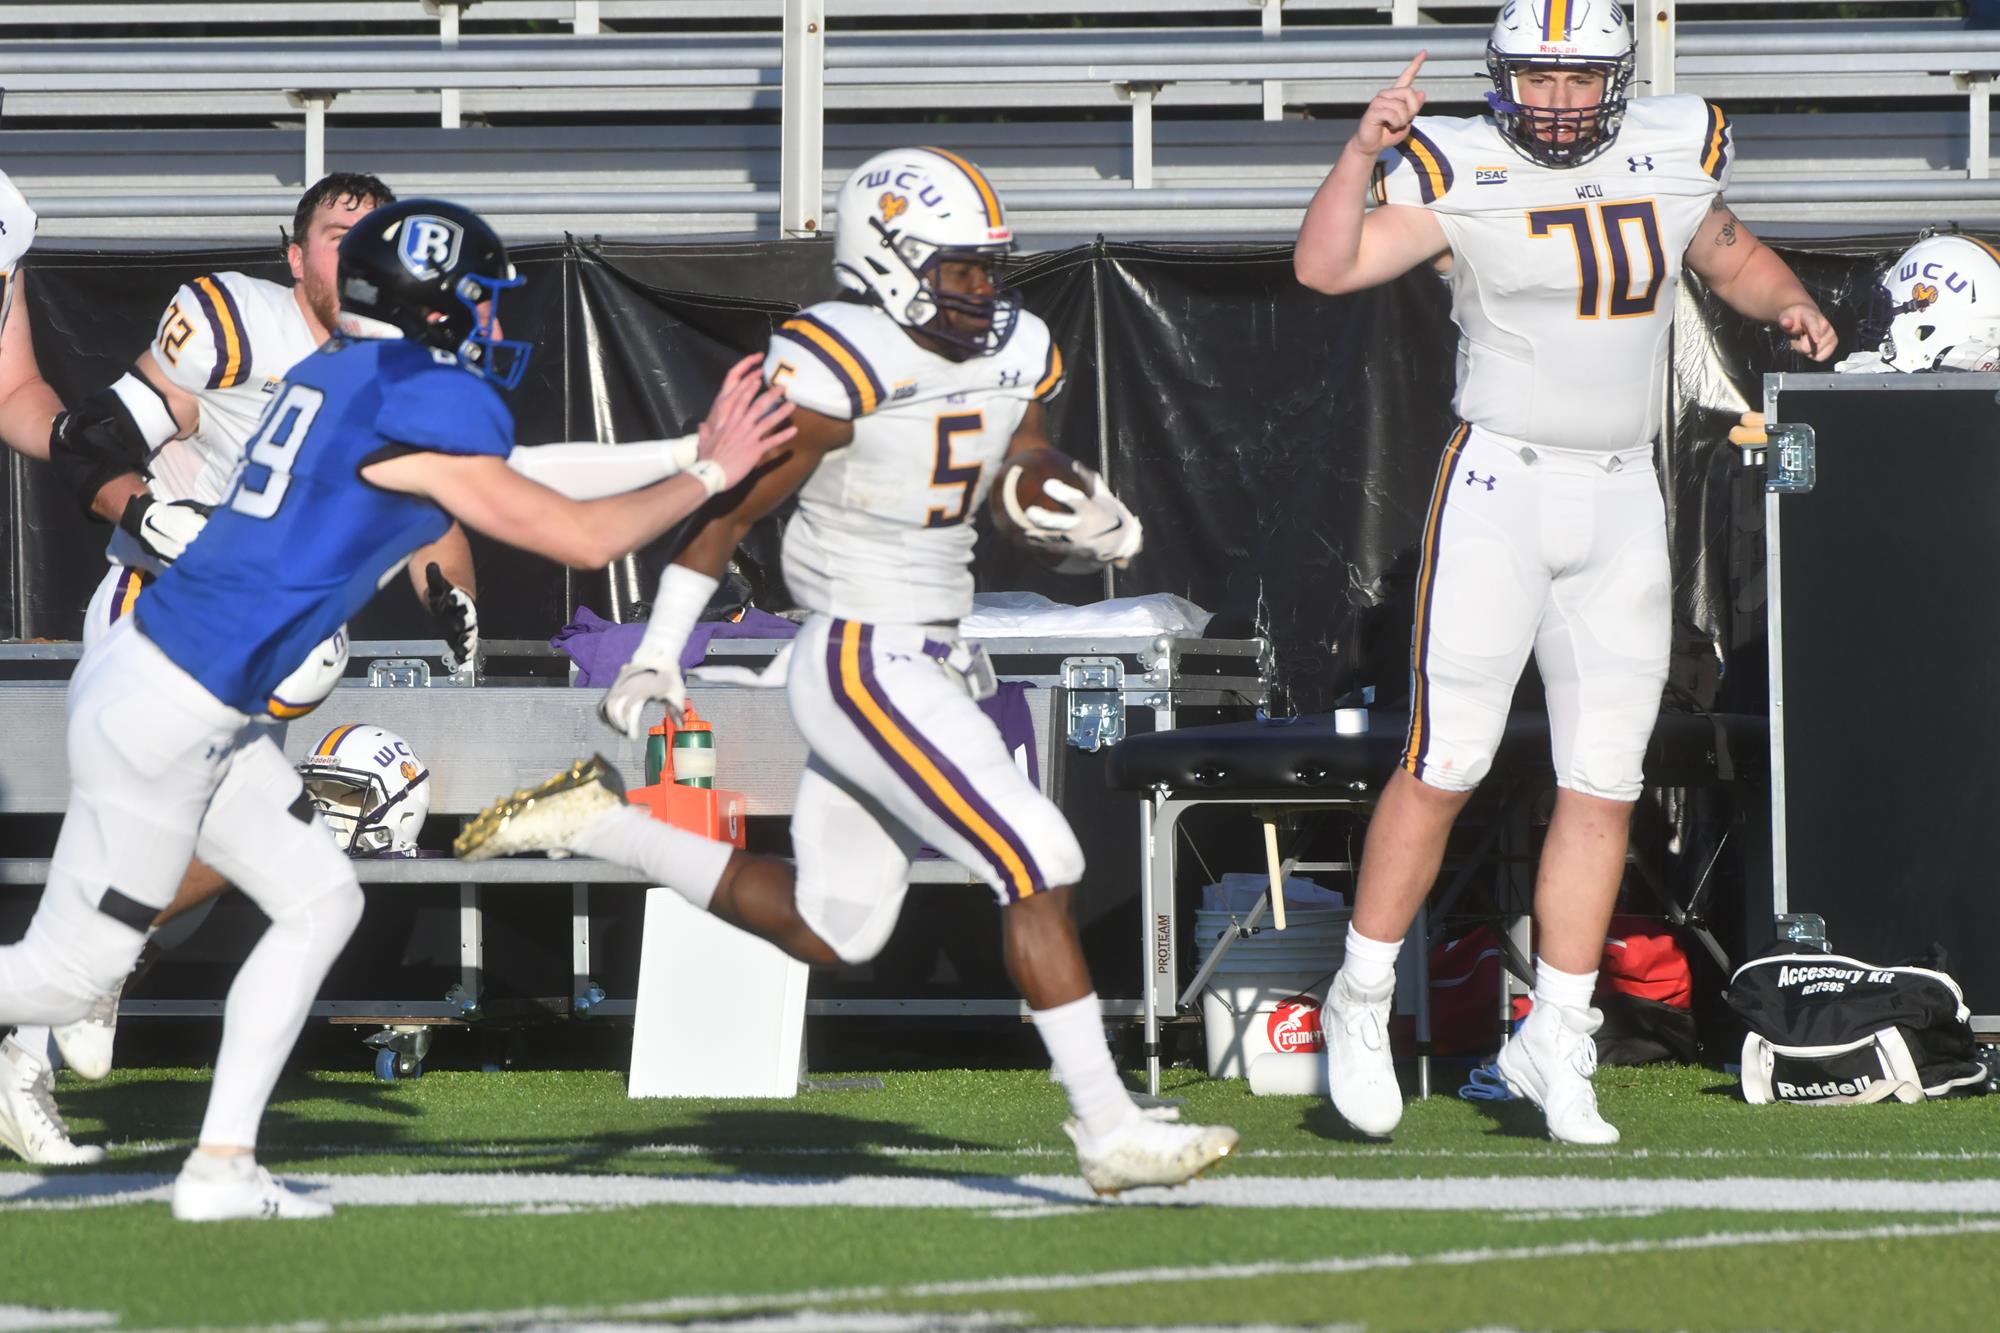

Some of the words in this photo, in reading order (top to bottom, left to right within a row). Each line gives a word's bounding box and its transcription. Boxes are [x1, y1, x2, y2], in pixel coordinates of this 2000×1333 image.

[866, 169, 944, 208] WCU
[1475, 170, 1508, 180] PSAC
[1575, 184, 1604, 199] WCU
[411, 221, 450, 263] R
[1524, 197, 1667, 321] 70
[1900, 261, 1969, 294] WCU
[925, 408, 985, 529] 5
[372, 740, 421, 768] WC
[1157, 914, 1169, 974] PROTEAM
[1777, 965, 1865, 988] Accessory
[1867, 971, 1896, 984] Kit
[1801, 981, 1845, 996] R27595
[1777, 1074, 1872, 1098] Riddell
